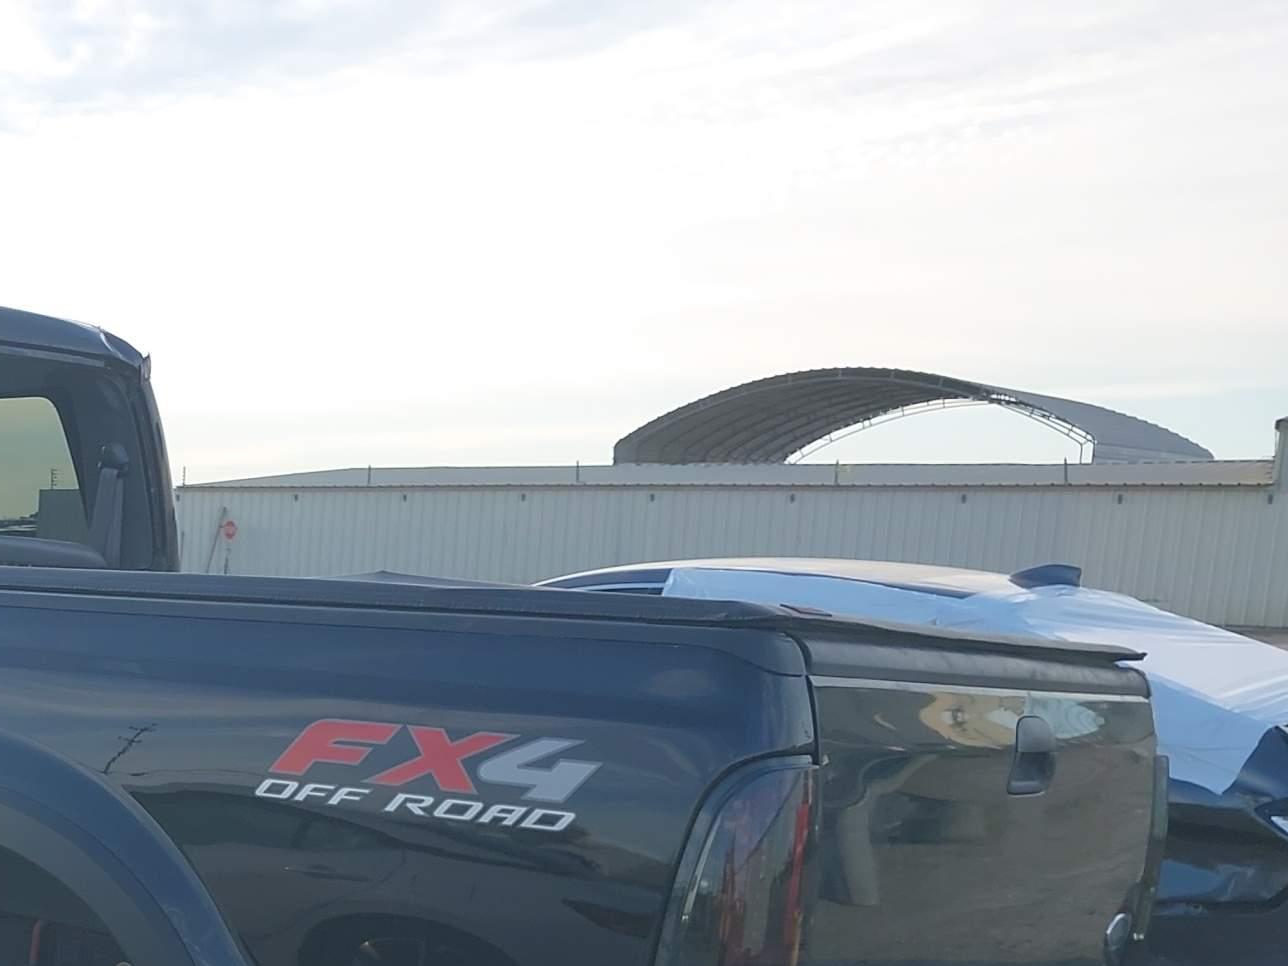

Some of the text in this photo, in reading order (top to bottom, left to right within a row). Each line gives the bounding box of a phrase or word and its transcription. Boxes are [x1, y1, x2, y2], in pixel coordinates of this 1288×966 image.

[267, 718, 604, 803] FX4
[254, 777, 577, 832] OFF ROAD
